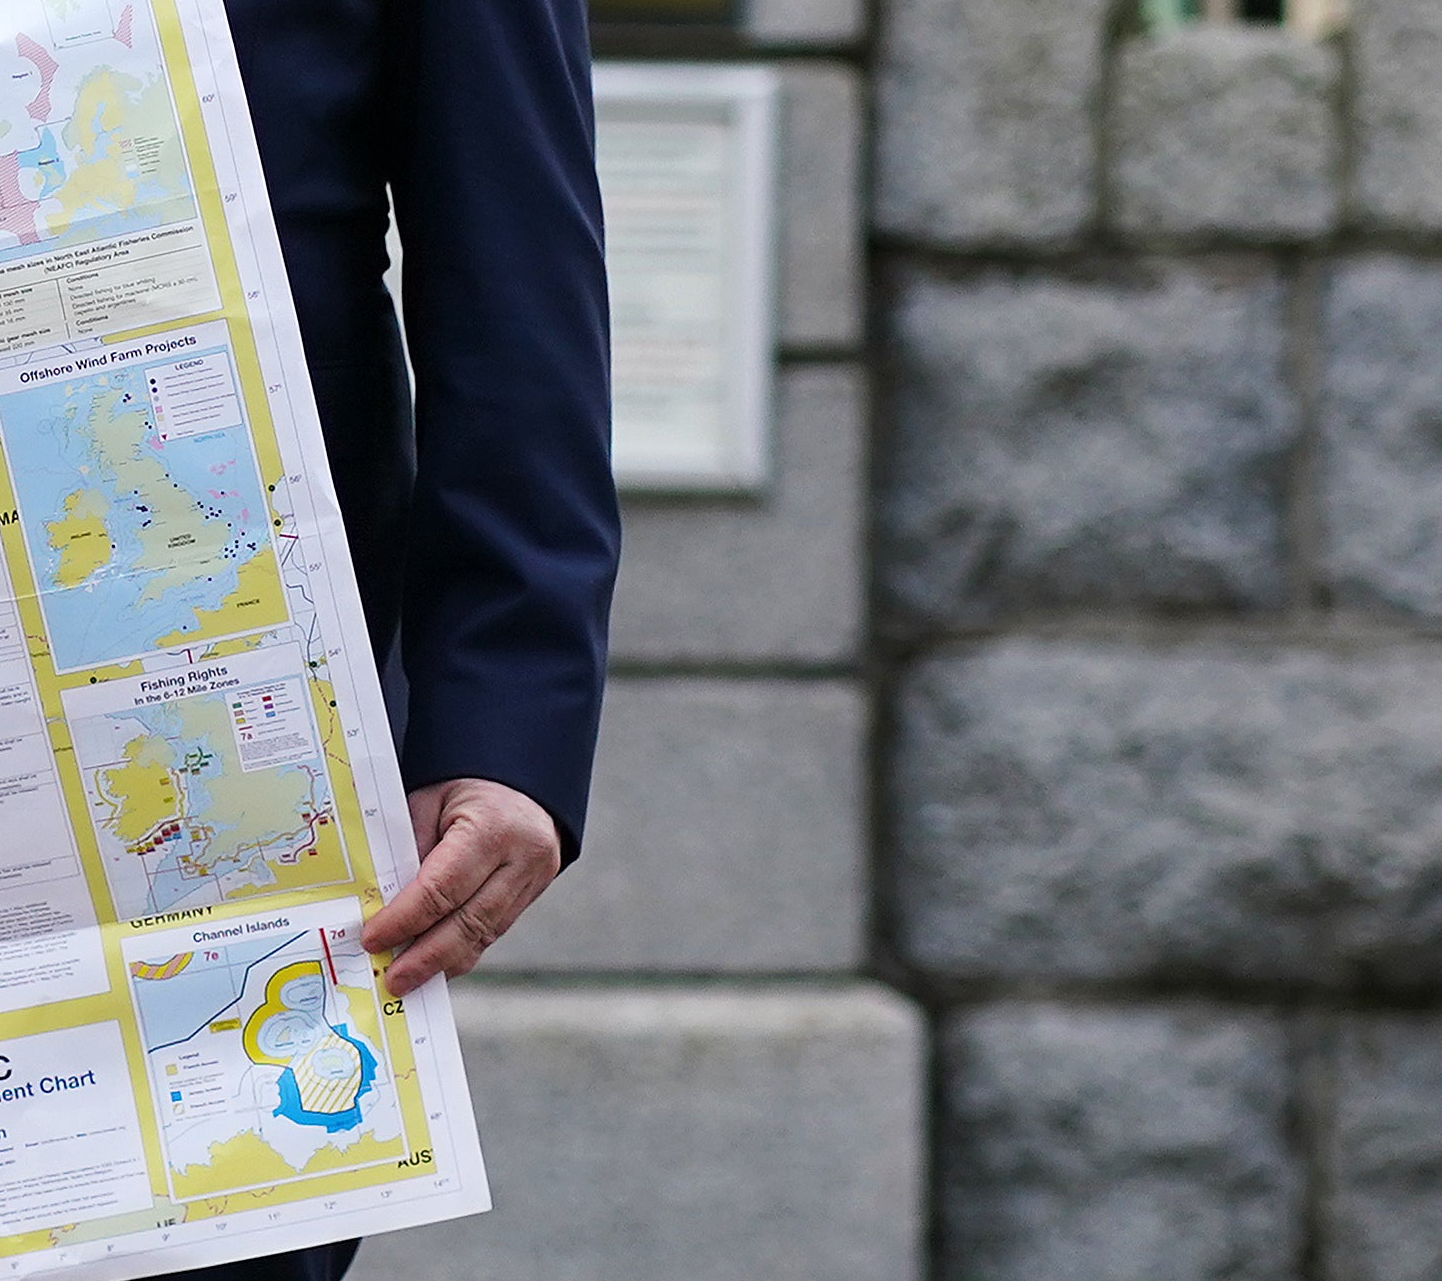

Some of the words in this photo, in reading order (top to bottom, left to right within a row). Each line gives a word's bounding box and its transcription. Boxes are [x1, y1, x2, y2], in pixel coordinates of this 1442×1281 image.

[119, 236, 150, 247] Fisheries
[20, 365, 72, 383] Offshore
[75, 355, 107, 370] Wind
[110, 349, 142, 362] Farm
[145, 337, 196, 354] Projects
[175, 359, 203, 370] LEGEND
[141, 677, 185, 692] Fishing
[188, 667, 227, 682] Rights
[146, 695, 161, 703] the
[164, 688, 185, 699] 6-12
[187, 685, 207, 694] Mile
[209, 679, 239, 690] Zones
[193, 925, 243, 942] Channel
[246, 918, 289, 933] Islands
[331, 929, 345, 940] 7d
[204, 952, 219, 961] 7e
[40, 1070, 95, 1093] Chart
